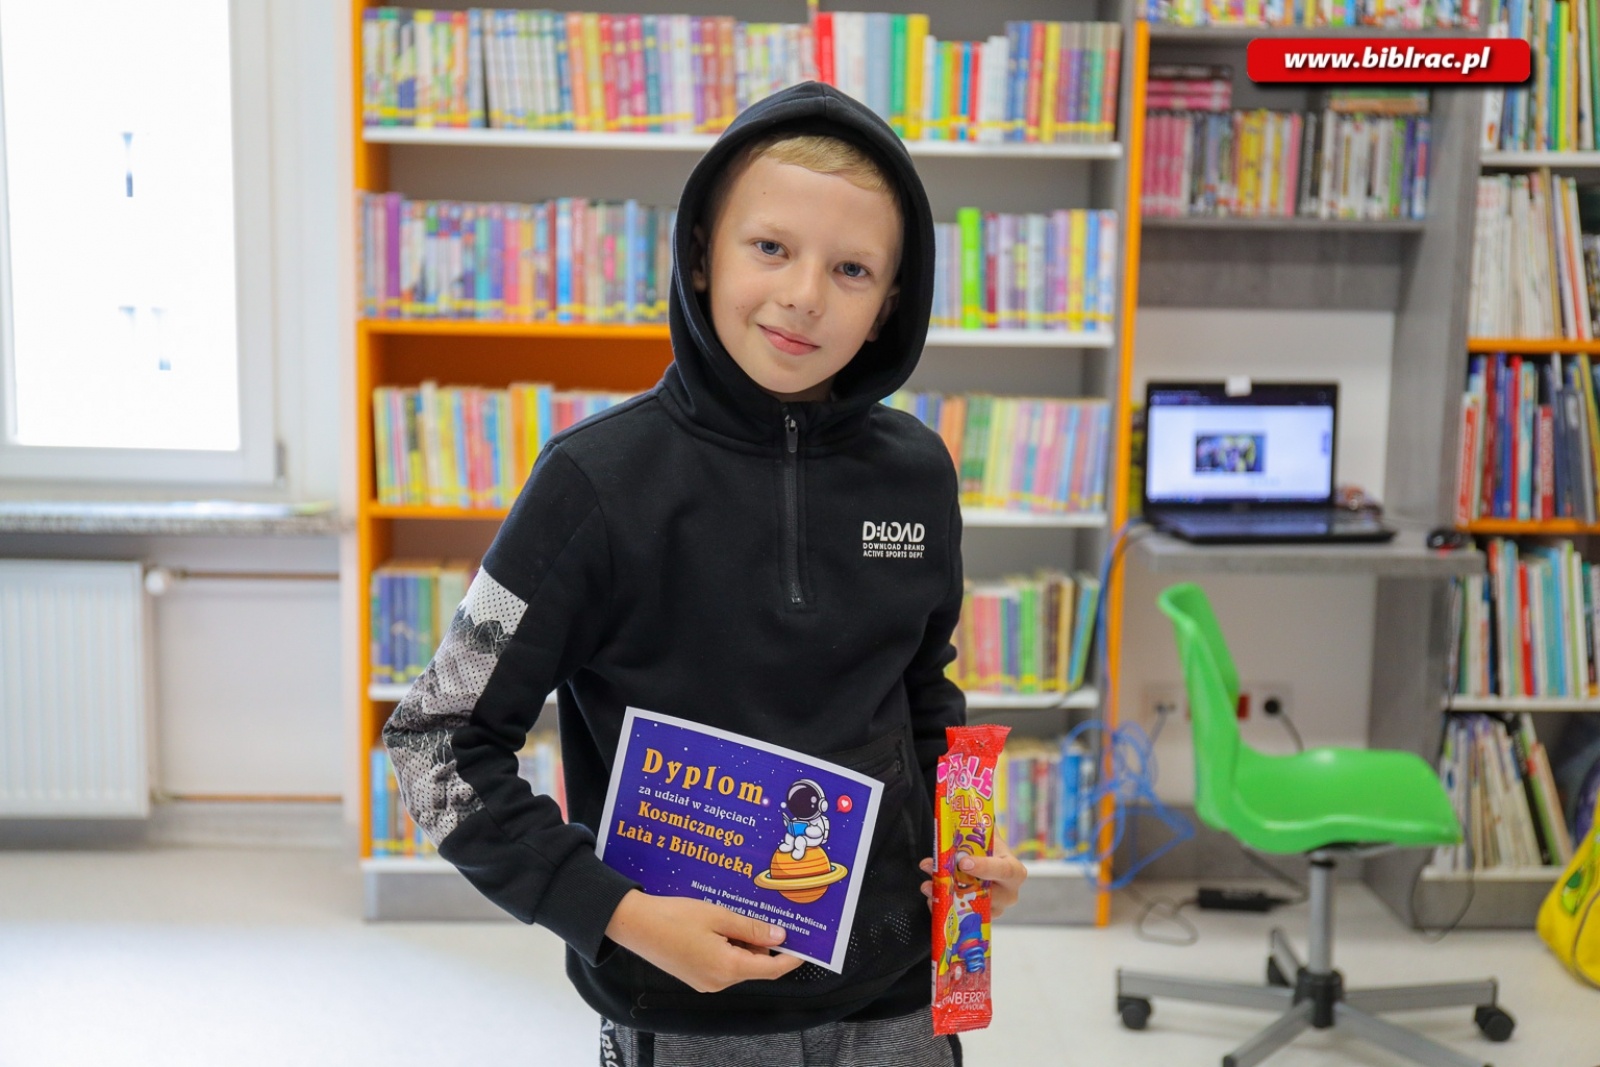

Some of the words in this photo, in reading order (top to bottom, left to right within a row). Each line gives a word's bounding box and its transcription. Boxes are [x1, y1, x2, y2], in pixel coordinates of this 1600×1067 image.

[862, 521, 925, 542] D:LOAD
[863, 550, 884, 558] ACTIVE
[641, 748, 763, 805] Dyplom
[638, 786, 651, 796] za
[654, 790, 690, 806] udział
[692, 801, 702, 810] w
[704, 804, 757, 827] zajęciach
[638, 801, 744, 847] Kosmicznego
[616, 820, 653, 844] Lata
[656, 835, 666, 848] z
[669, 836, 753, 878] Biblioteką
[691, 880, 717, 895] Miejska
[722, 890, 758, 907] Powiatowa
[760, 902, 794, 919] Biblioteka
[796, 913, 827, 931] Publiczna
[777, 919, 810, 936] Raciborzu
